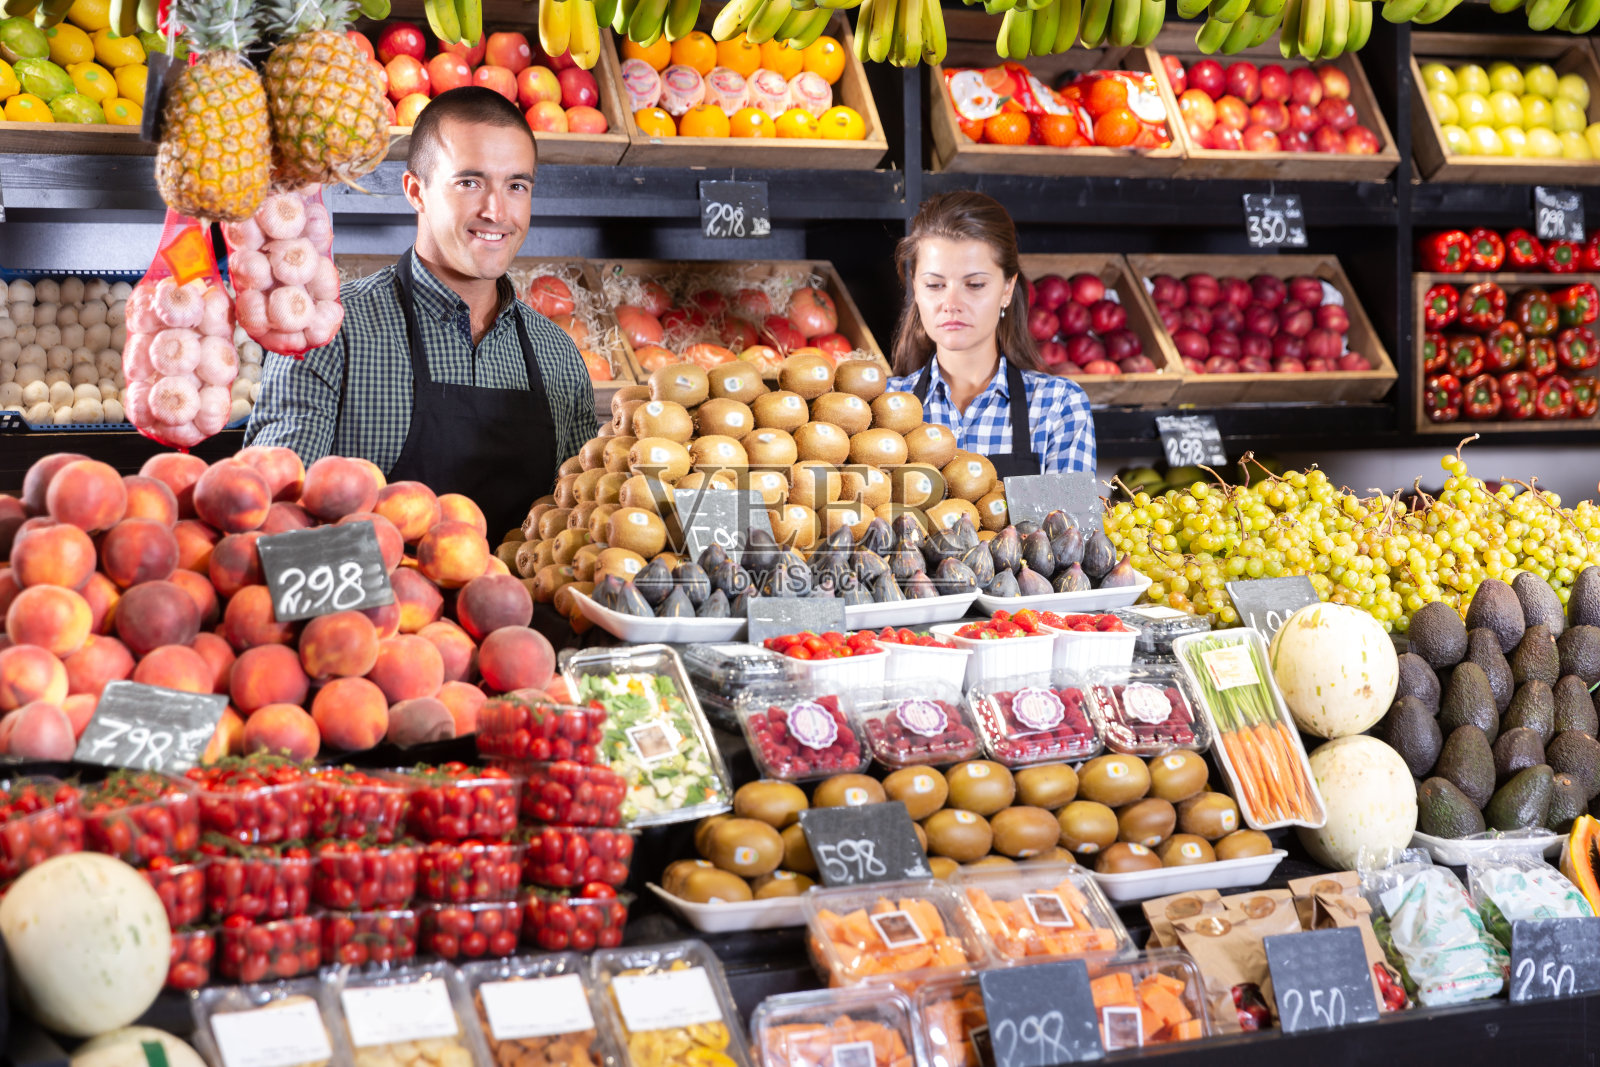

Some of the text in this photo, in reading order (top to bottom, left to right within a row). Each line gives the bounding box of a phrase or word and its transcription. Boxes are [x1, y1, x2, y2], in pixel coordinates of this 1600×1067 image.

[705, 201, 746, 238] 2,98
[1246, 215, 1286, 247] 3,50
[278, 560, 366, 615] 2,98
